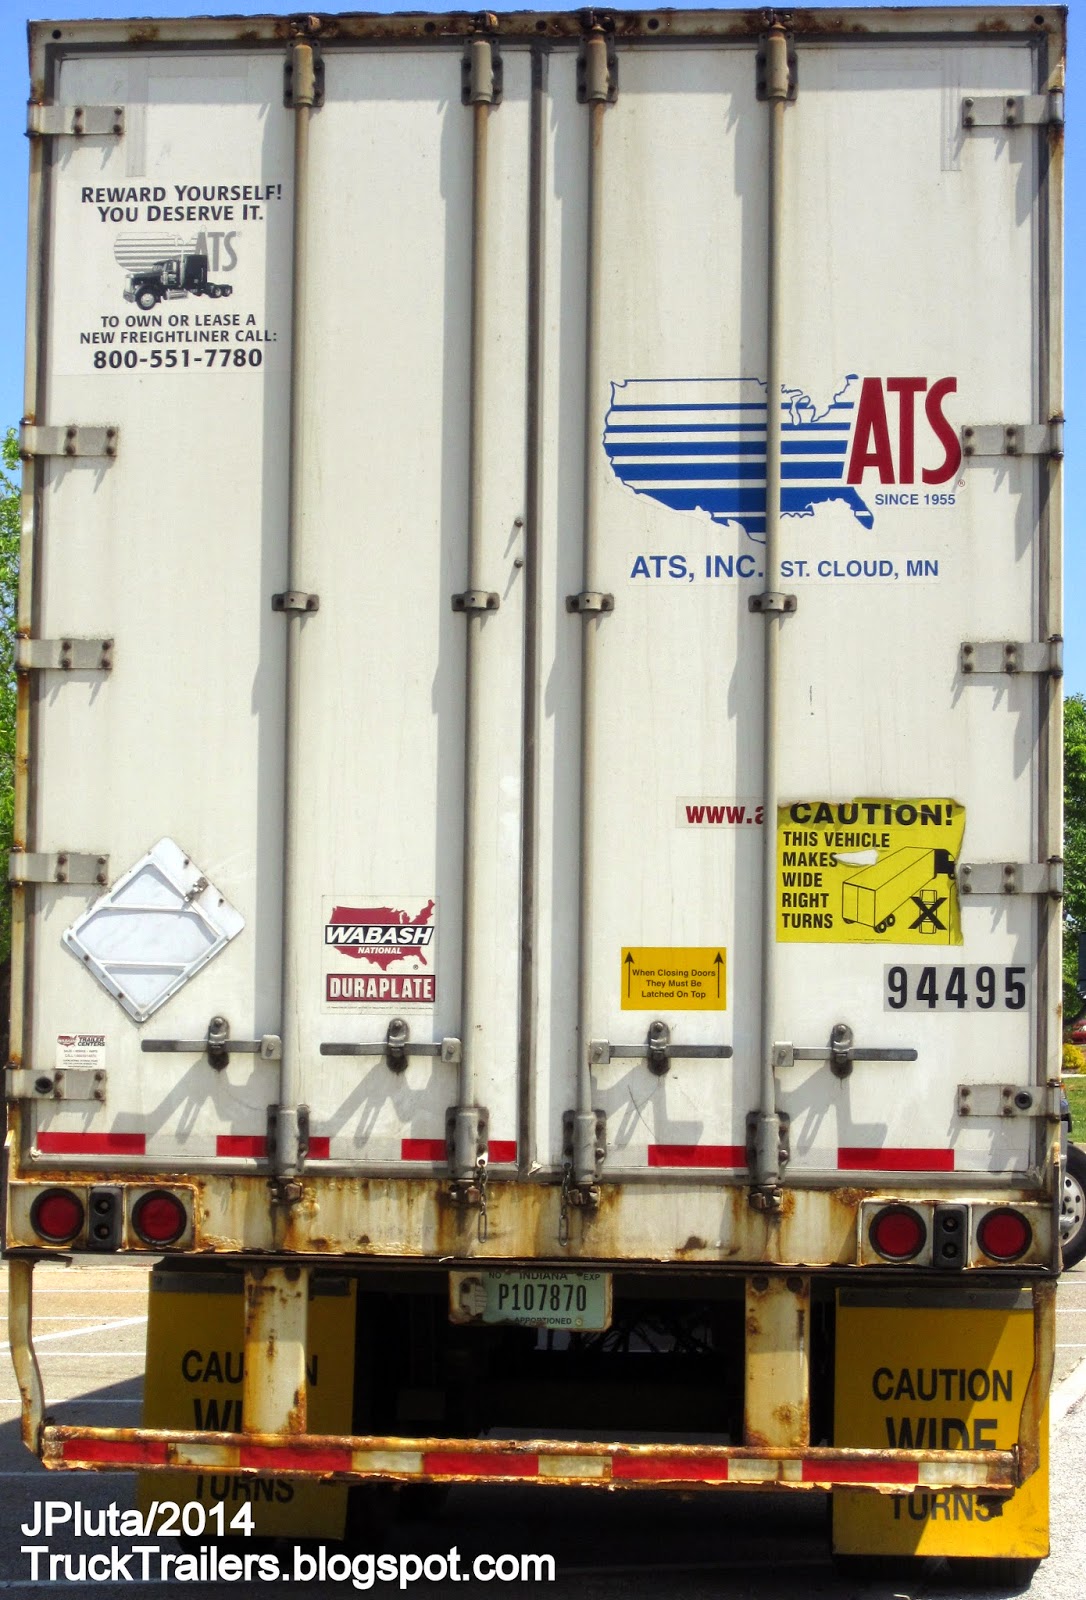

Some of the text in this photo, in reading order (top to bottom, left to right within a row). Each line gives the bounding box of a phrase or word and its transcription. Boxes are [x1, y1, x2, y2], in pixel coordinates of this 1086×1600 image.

[81, 184, 282, 203] REWARD YOURSELF!
[97, 204, 264, 222] YOU DESERVE IT.
[101, 314, 256, 328] TO OWN OR LEASE A
[80, 330, 278, 344] NEW FREIGHTLINER CALL:
[93, 349, 262, 369] 800-551-7780
[846, 376, 962, 485] ATS
[875, 493, 956, 506] SINCE 1955
[630, 555, 939, 582] ATS, INC. ST. CLOUD, MN
[789, 802, 953, 826] CAUTION!
[783, 831, 890, 848] THIS VEHICLE
[782, 852, 838, 867] MAKES
[782, 872, 822, 888] WIDE
[782, 893, 829, 908] RIGHT
[782, 913, 833, 929] TURNS
[326, 926, 433, 944] WABASH
[632, 969, 716, 978] When Closing Doors
[329, 977, 432, 999] DURAPLATE
[646, 980, 666, 988] They
[888, 966, 1026, 1009] 94495
[641, 990, 674, 998] Latched
[691, 991, 706, 999] Top
[520, 1272, 568, 1280] INDIANA
[583, 1273, 600, 1281] EXP
[498, 1283, 587, 1312] P107870
[181, 1350, 318, 1387] CAUN
[872, 1367, 1013, 1402] CAUTION
